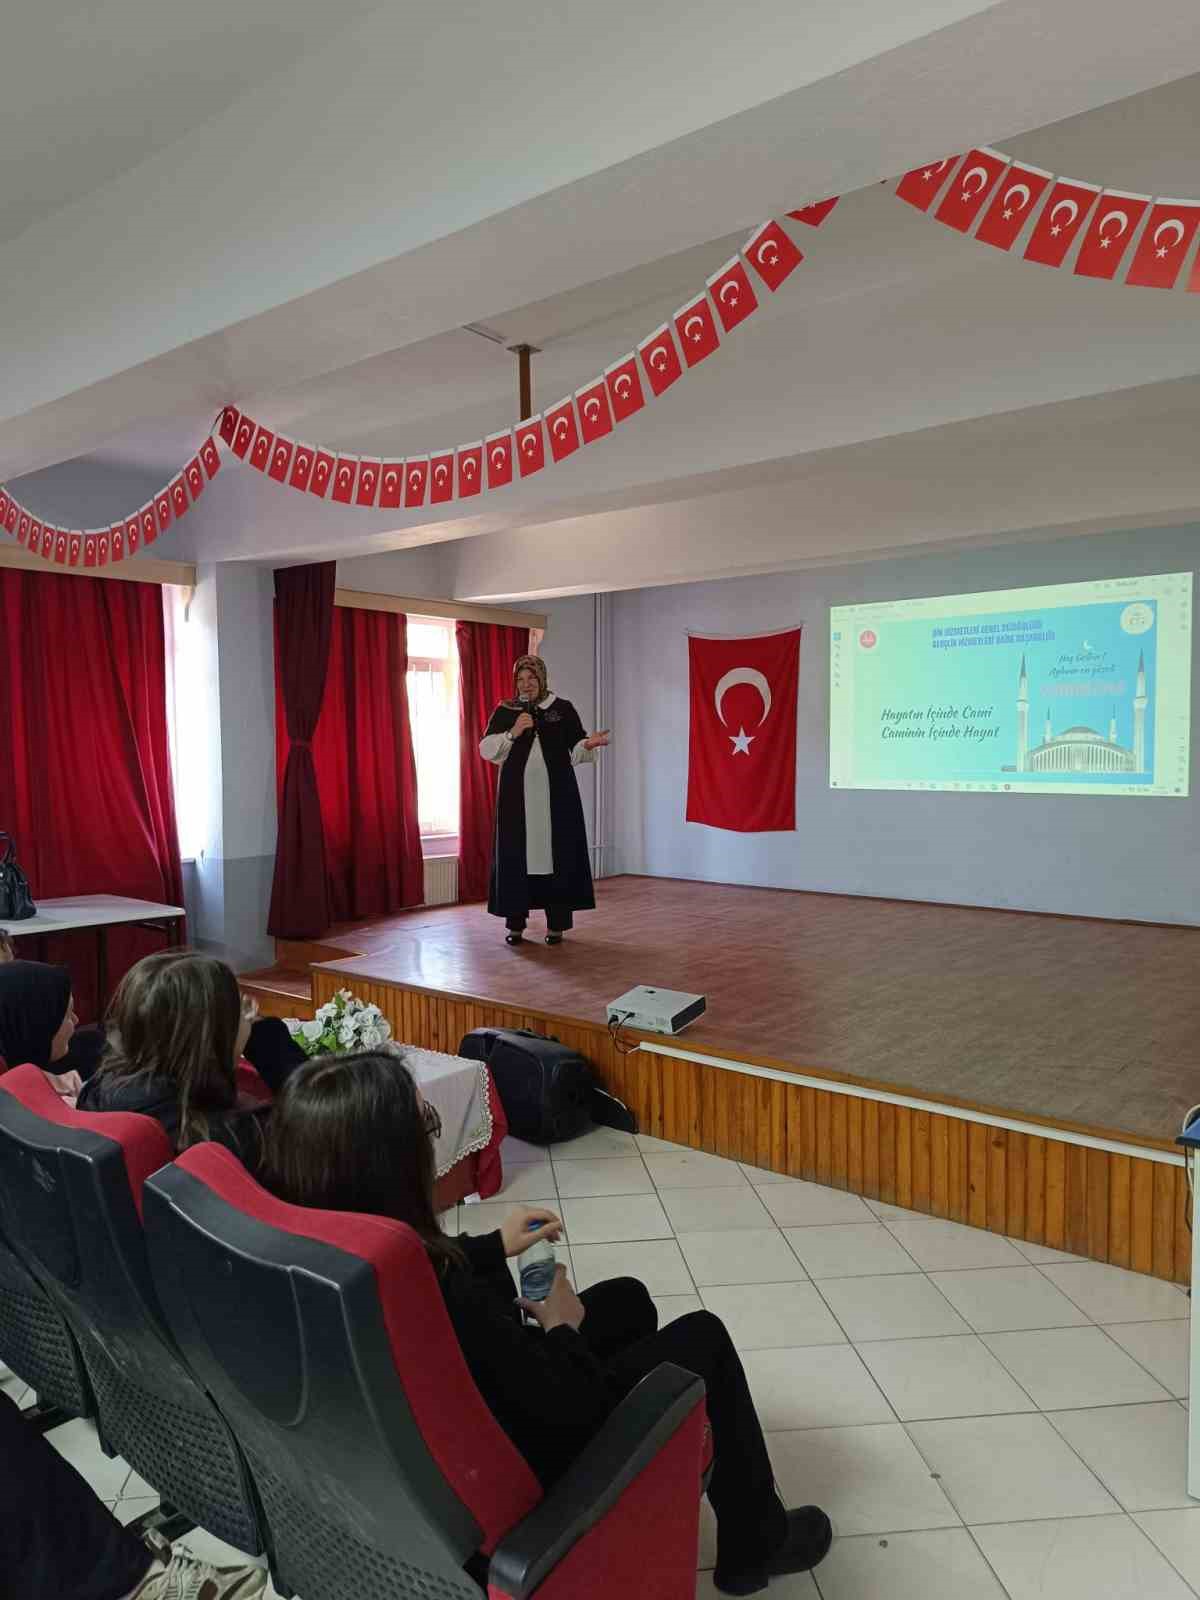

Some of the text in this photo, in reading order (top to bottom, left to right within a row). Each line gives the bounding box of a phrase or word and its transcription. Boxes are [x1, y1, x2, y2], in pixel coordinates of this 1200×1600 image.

[962, 705, 993, 719] Cami
[881, 726, 925, 740] Caminin
[963, 724, 1000, 743] Hayat
